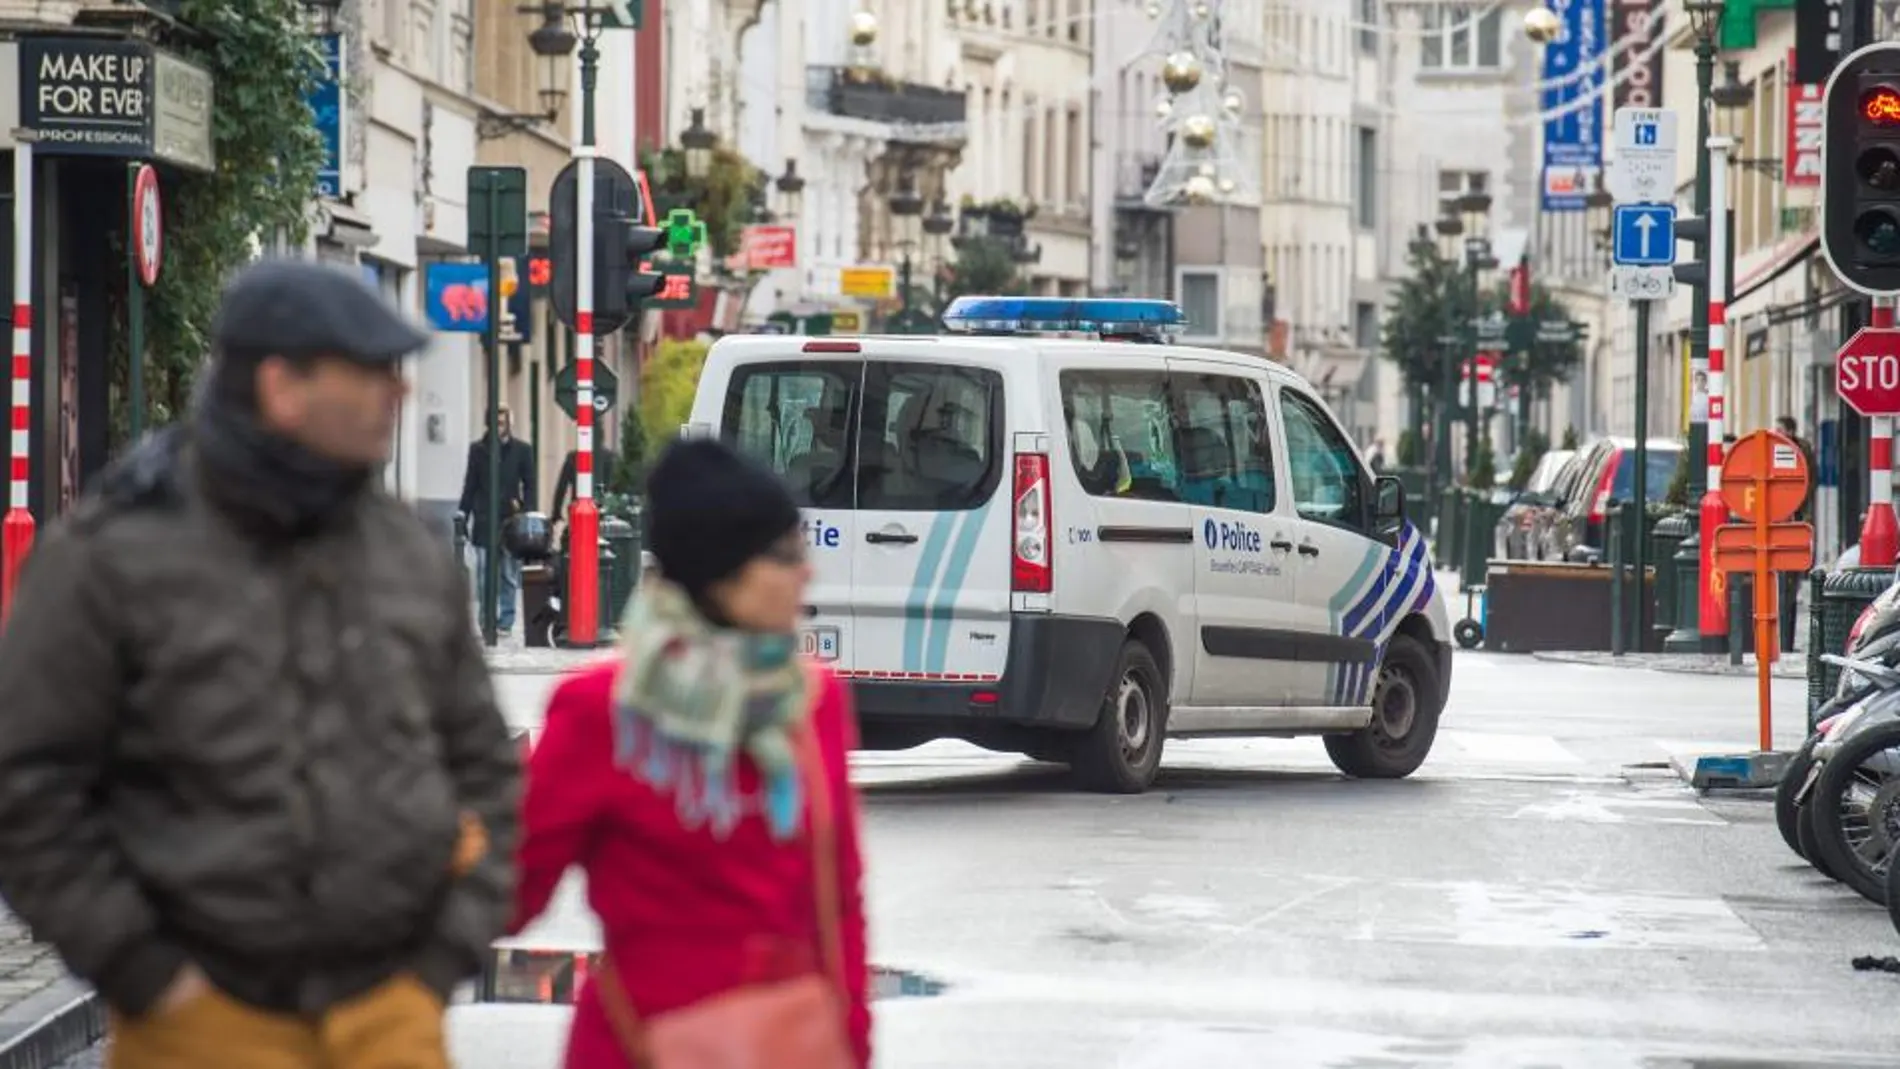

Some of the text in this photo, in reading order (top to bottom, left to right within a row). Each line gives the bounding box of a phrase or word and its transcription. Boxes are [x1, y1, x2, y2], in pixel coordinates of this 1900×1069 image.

[40, 53, 144, 83] MAKE UP
[39, 86, 94, 114] FOR
[100, 88, 143, 116] EVER
[1841, 355, 1899, 390] STO
[801, 519, 840, 547] tie
[1220, 522, 1261, 553] Police
